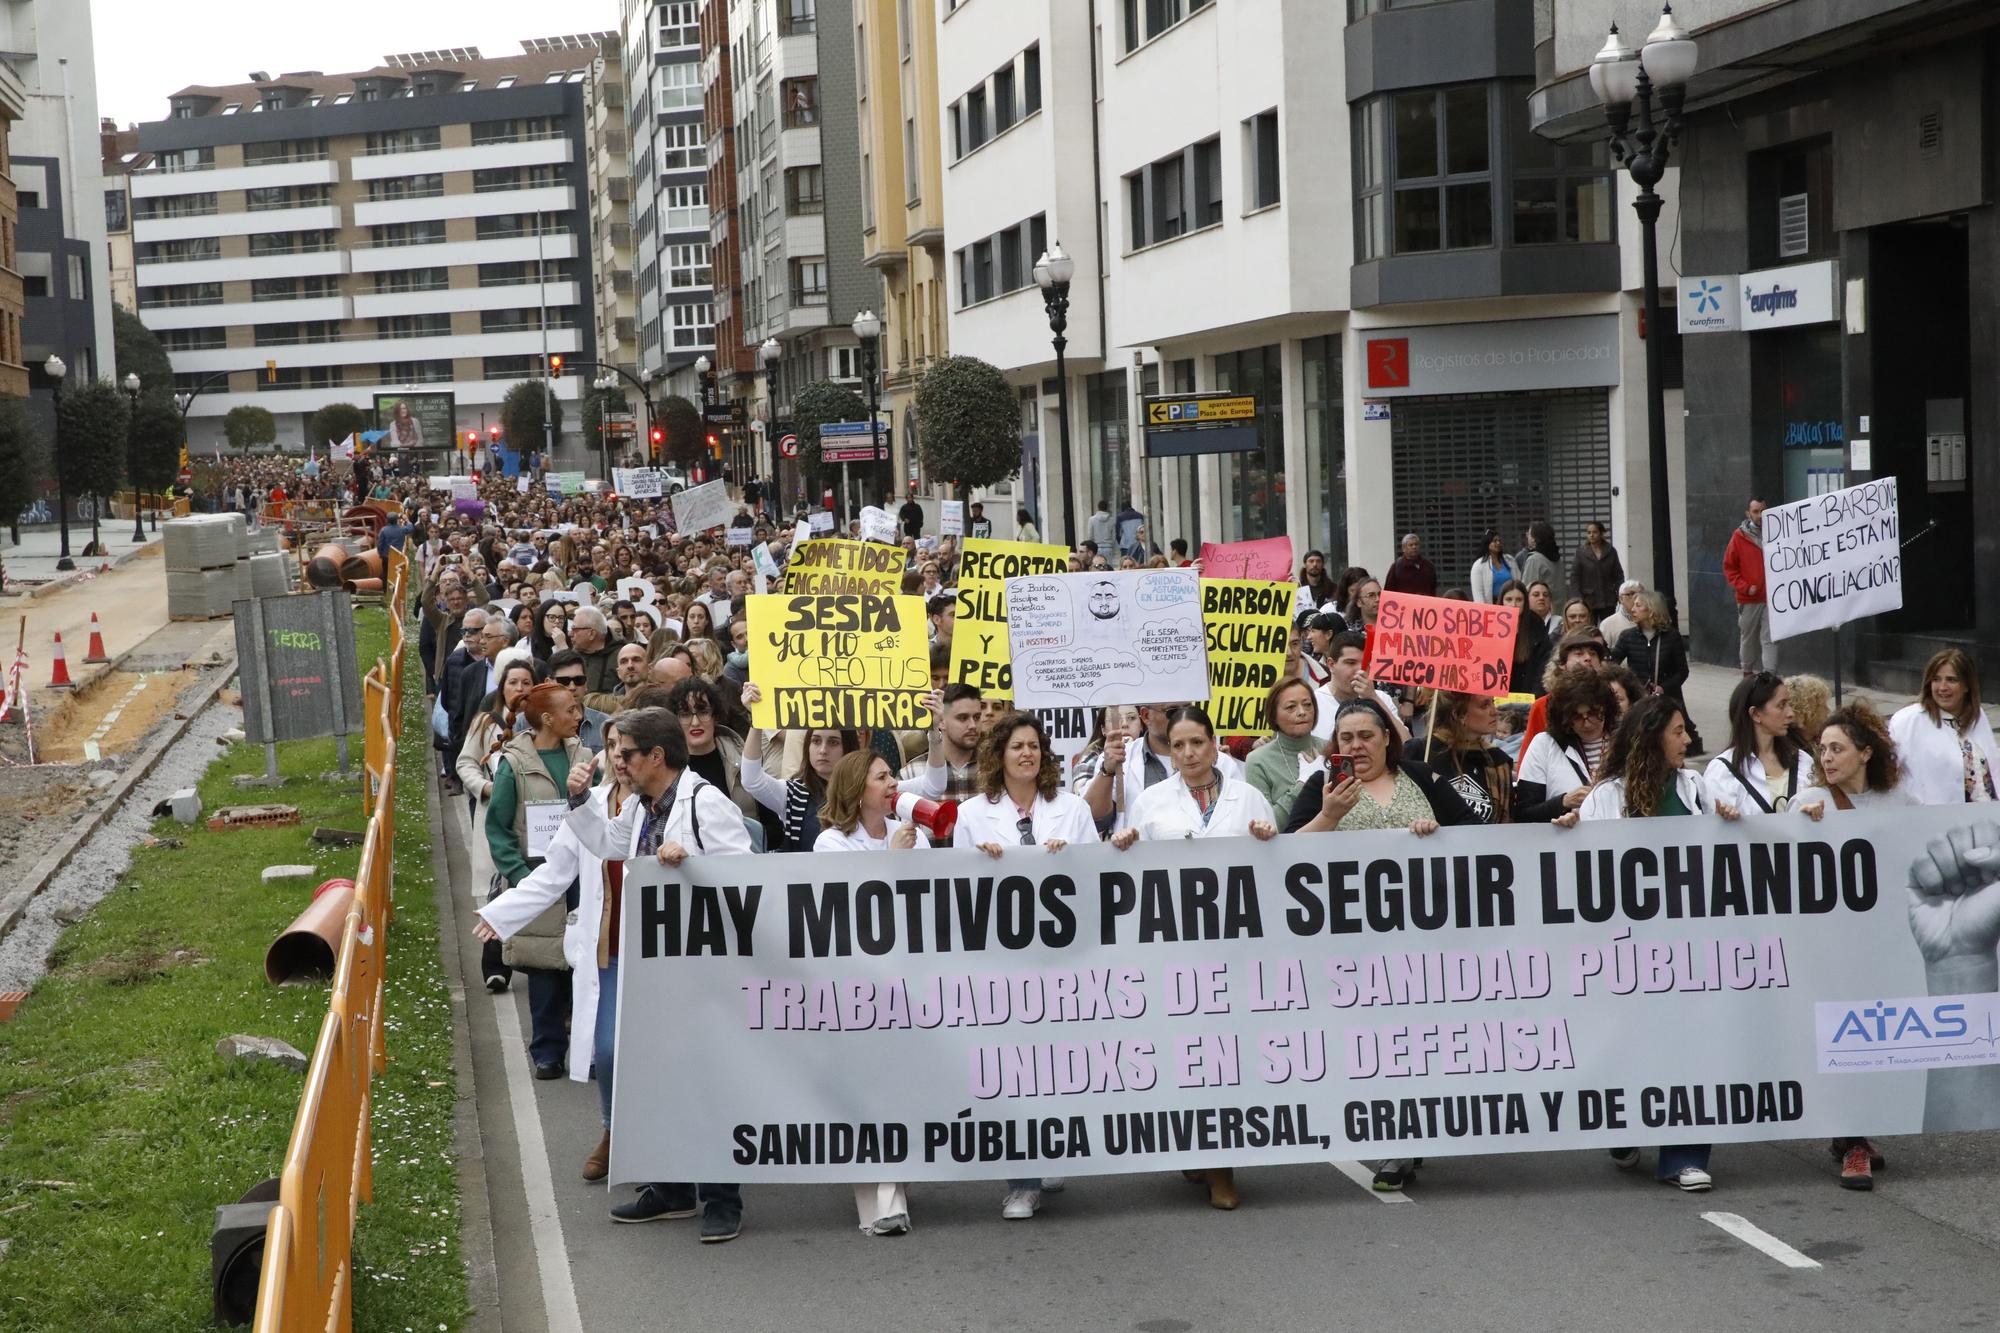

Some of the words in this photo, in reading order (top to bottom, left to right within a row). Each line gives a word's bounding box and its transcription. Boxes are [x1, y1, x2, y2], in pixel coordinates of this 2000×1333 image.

[1751, 284, 1798, 316] eurofirms
[1689, 317, 1725, 326] eurofirms
[1414, 353, 1480, 372] Registros
[1485, 351, 1507, 365] de
[1509, 350, 1524, 364] la
[1528, 344, 1610, 366] Propiedad
[1209, 400, 1253, 409] aparcamiento
[1770, 539, 1830, 573] ¿DÓNDE
[1837, 517, 1879, 552] ESTÁ
[785, 571, 896, 595] ENGAÑADOS
[1145, 576, 1182, 585] SANIDAD
[1152, 585, 1197, 594] ASTURIANA
[1010, 594, 1038, 603] disculpe
[1011, 603, 1045, 611] molestias
[1141, 594, 1152, 602] EN
[1155, 594, 1183, 602] LUCHA
[1203, 582, 1291, 616] BARBÓN
[785, 595, 901, 632] SESPA
[1011, 613, 1022, 621] los
[1413, 608, 1438, 630] NO
[1443, 607, 1512, 638] SABES
[979, 634, 994, 654] Y
[1141, 636, 1172, 644] NECESITA
[1174, 635, 1202, 643] GESTORES
[1146, 629, 1155, 637] EL
[1158, 628, 1180, 636] SESPA
[1204, 622, 1287, 653] SCUCHA
[769, 631, 814, 662] ya
[821, 631, 860, 657] no
[1141, 644, 1188, 652] COMPETENTES
[1151, 653, 1187, 661] DECENTES
[798, 656, 865, 687] CREO
[865, 656, 929, 689] TUS
[1035, 658, 1066, 666] CONTRATOS
[1035, 666, 1073, 675] CONDICIONES
[1075, 663, 1111, 671] LABORALES
[1114, 661, 1136, 669] DIGNAS
[1209, 657, 1277, 688] NIDAD
[1045, 673, 1076, 681] SALARIOS
[1439, 664, 1469, 690] HAS
[1028, 708, 1086, 738] CHA
[1215, 696, 1271, 730] LUCH
[640, 882, 763, 959] HAY
[787, 874, 1077, 959] MOTIVOS
[1099, 865, 1262, 945] PARA
[1284, 853, 1515, 937] SEGUIR
[1540, 838, 1878, 924] LUCHANDO
[741, 967, 1146, 1032] TRABAJADORXS
[1166, 962, 1231, 1017] DE
[1250, 958, 1309, 1013] LA
[1328, 946, 1551, 1009] SANIDAD
[1572, 926, 1790, 997] PÚBLICA
[1832, 1000, 1967, 1043] ATAS
[970, 1038, 1157, 1100] UNIDXS
[1177, 1033, 1240, 1089] EN
[1257, 1029, 1327, 1084] SU
[1346, 1018, 1576, 1082] DEFENSA
[732, 1123, 908, 1166] SANIDAD
[924, 1108, 1091, 1164] PÚBLICA
[1103, 1103, 1331, 1156] UNIVERSAL,
[1343, 1092, 1529, 1143] GRATUITA
[1542, 1091, 1565, 1133] Y
[1578, 1087, 1626, 1132] DE
[1641, 1080, 1804, 1128] CALIDAD
